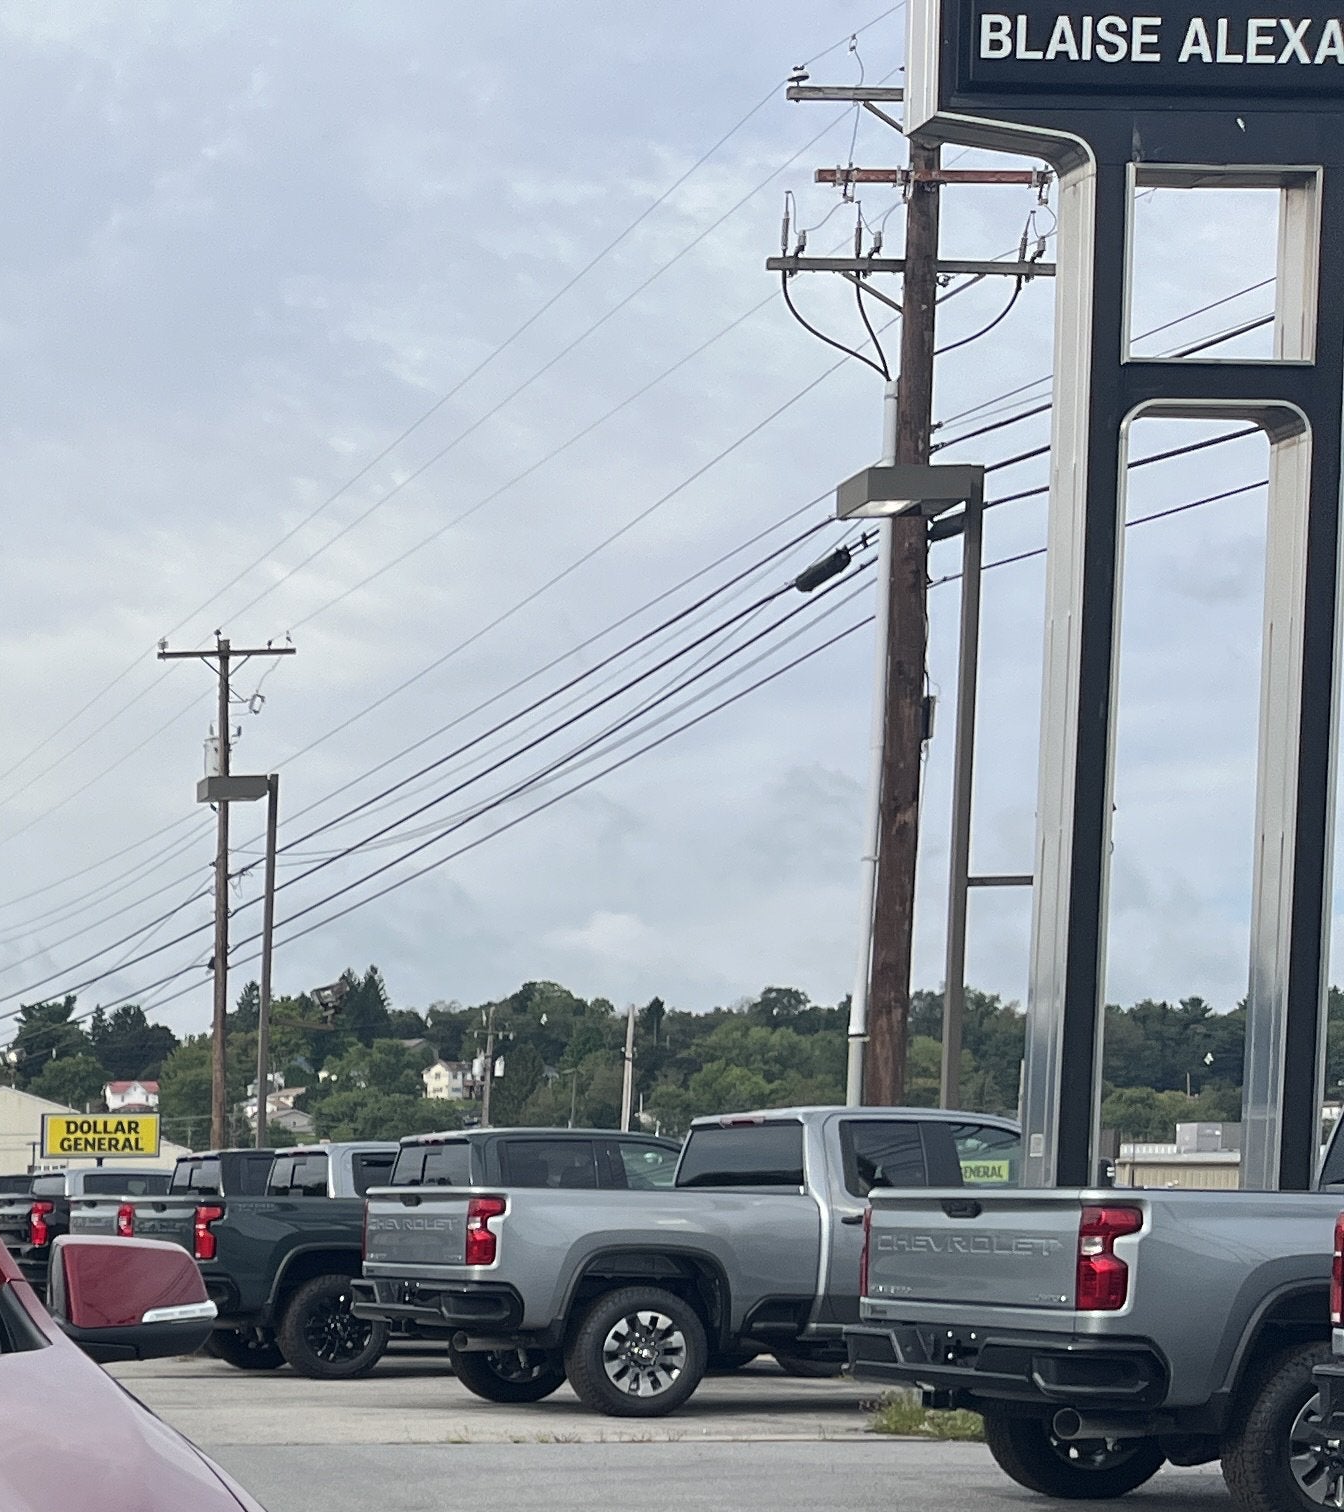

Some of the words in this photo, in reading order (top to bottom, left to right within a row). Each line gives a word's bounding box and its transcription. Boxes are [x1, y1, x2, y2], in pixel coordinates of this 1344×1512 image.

[979, 13, 1162, 63] BLAISE
[1177, 17, 1344, 65] ALEXA
[65, 1119, 140, 1135] DOLLAR
[59, 1136, 145, 1152] GENERAL
[963, 1165, 1003, 1178] ENERAL
[368, 1217, 456, 1231] CHEVROLET
[877, 1234, 1062, 1256] CHEVROLET
